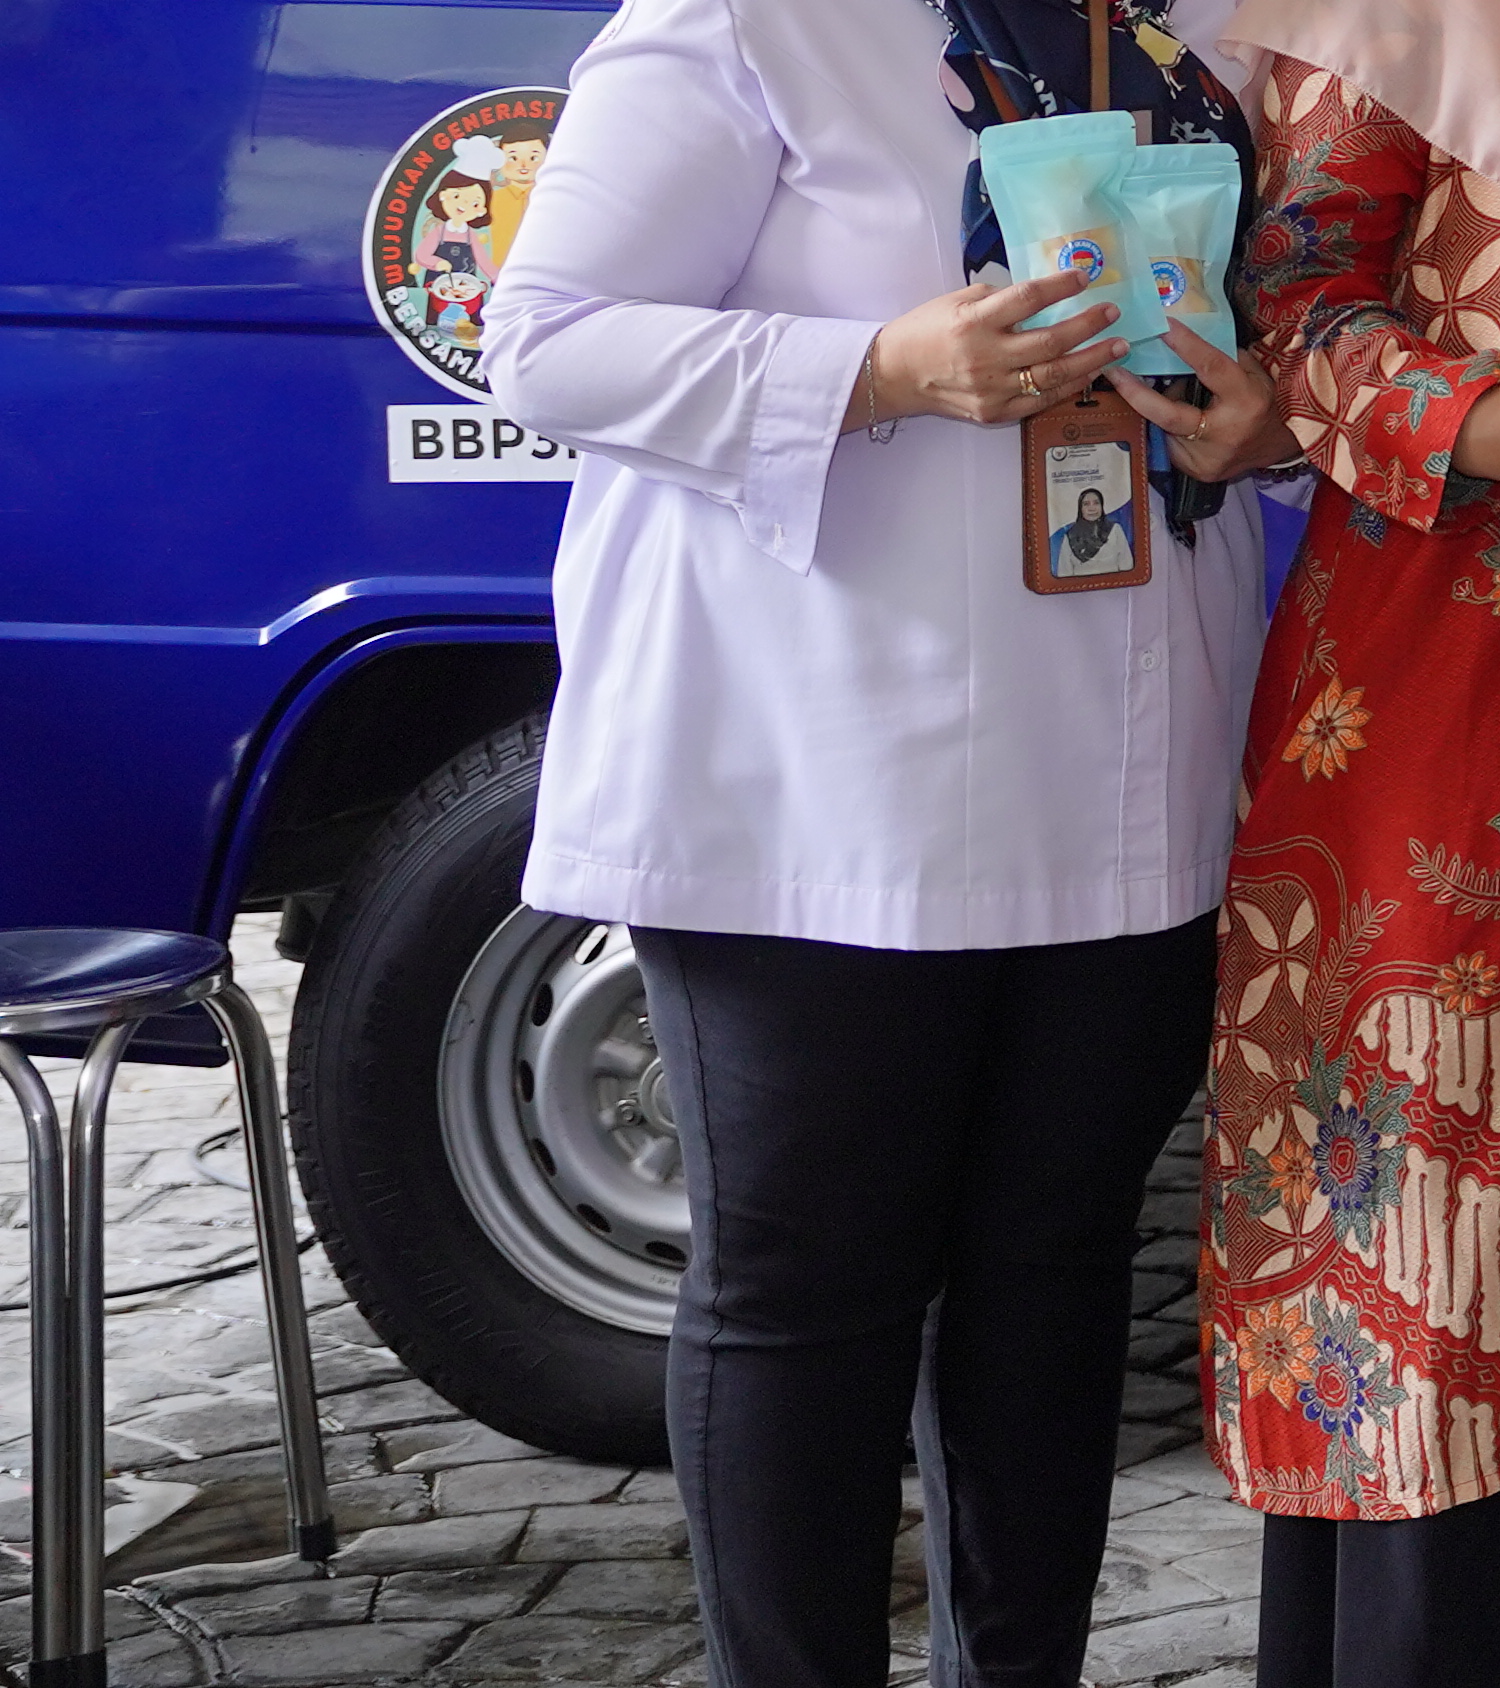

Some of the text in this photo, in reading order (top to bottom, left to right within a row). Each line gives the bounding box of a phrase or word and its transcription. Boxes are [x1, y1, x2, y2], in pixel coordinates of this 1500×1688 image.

[381, 99, 556, 285] WUJUDKAN GENERASI
[411, 418, 578, 461] BBP3
